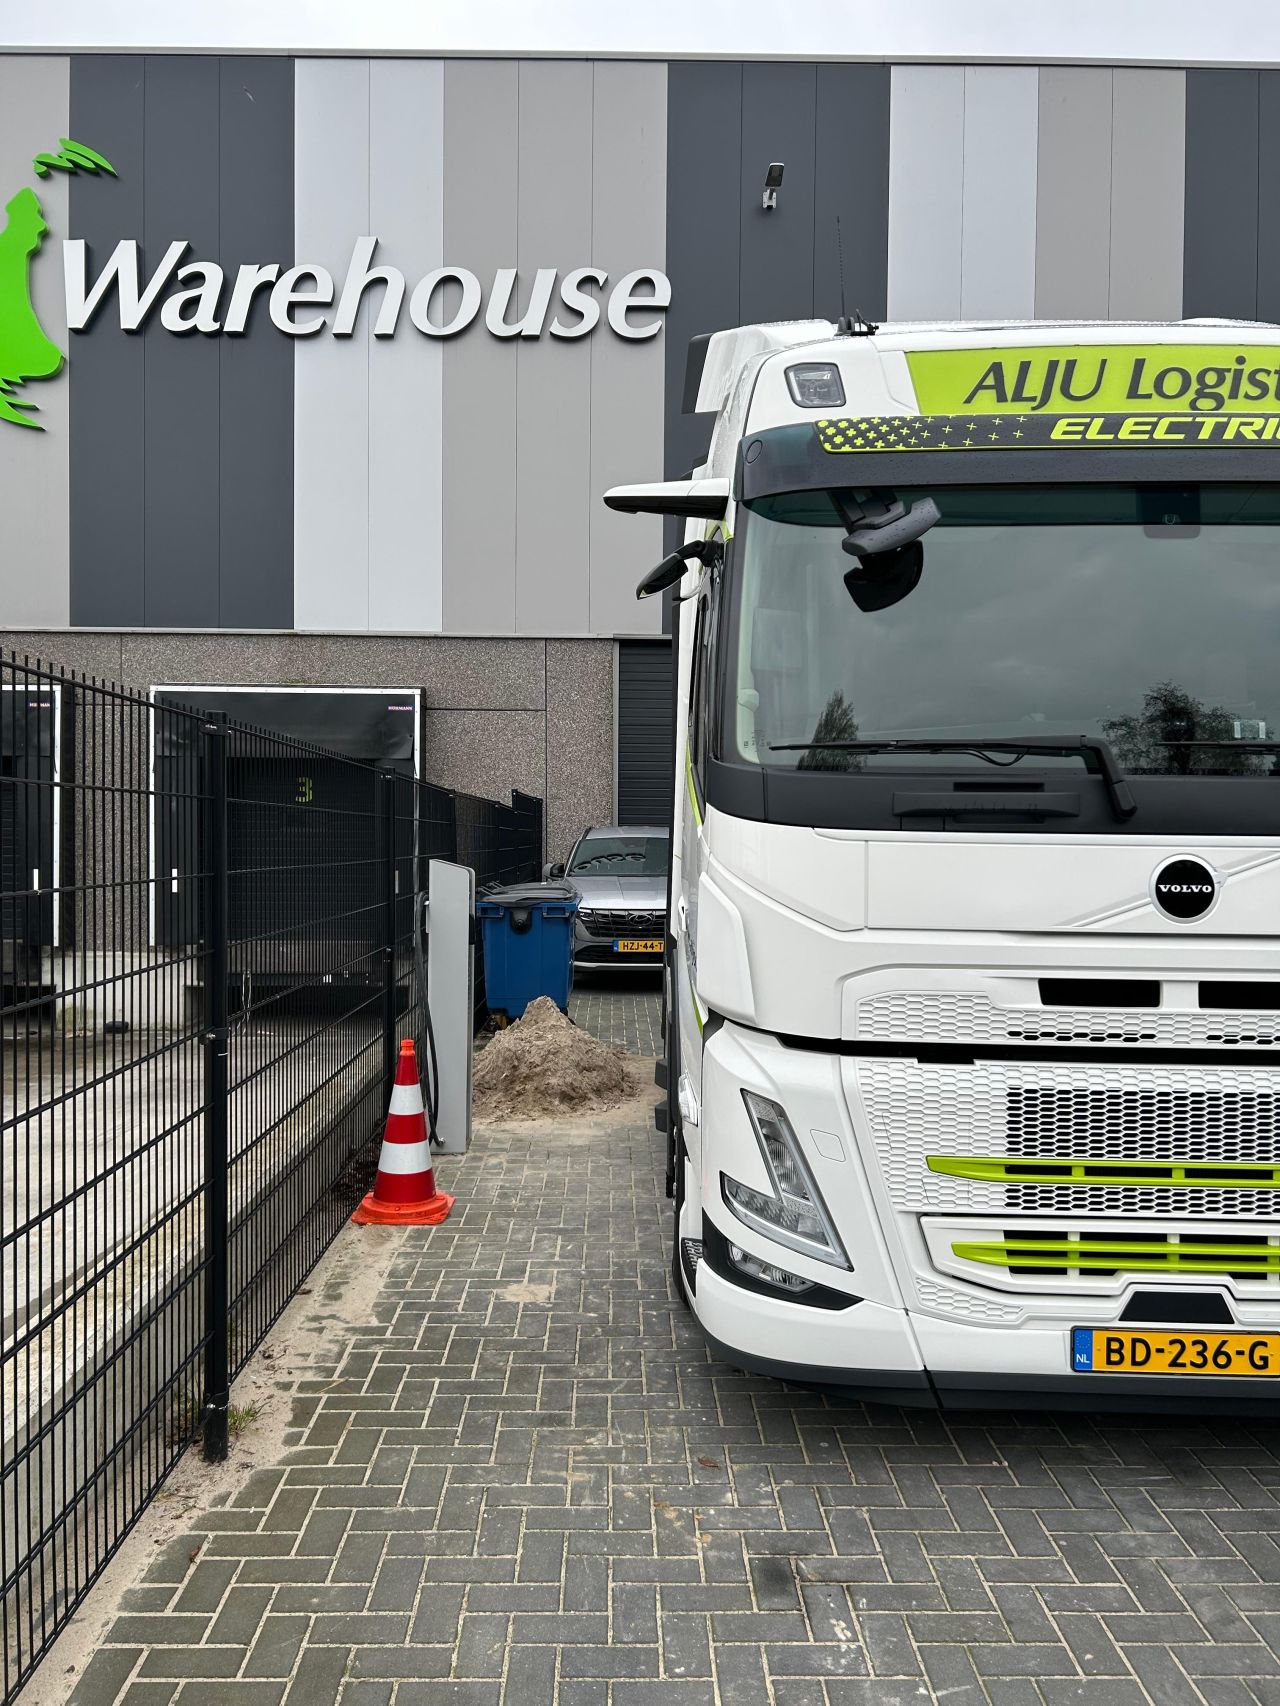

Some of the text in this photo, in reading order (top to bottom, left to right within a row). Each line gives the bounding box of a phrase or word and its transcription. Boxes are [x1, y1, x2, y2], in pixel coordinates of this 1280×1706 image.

[62, 236, 672, 341] Warehouse
[963, 358, 1107, 411] ALJU
[1049, 417, 1280, 440] ELECTRI
[295, 776, 313, 803] 3
[1157, 884, 1212, 893] VOLVO
[622, 941, 664, 951] HZJ-44-T
[1076, 1336, 1269, 1370] NL BD-236-G
